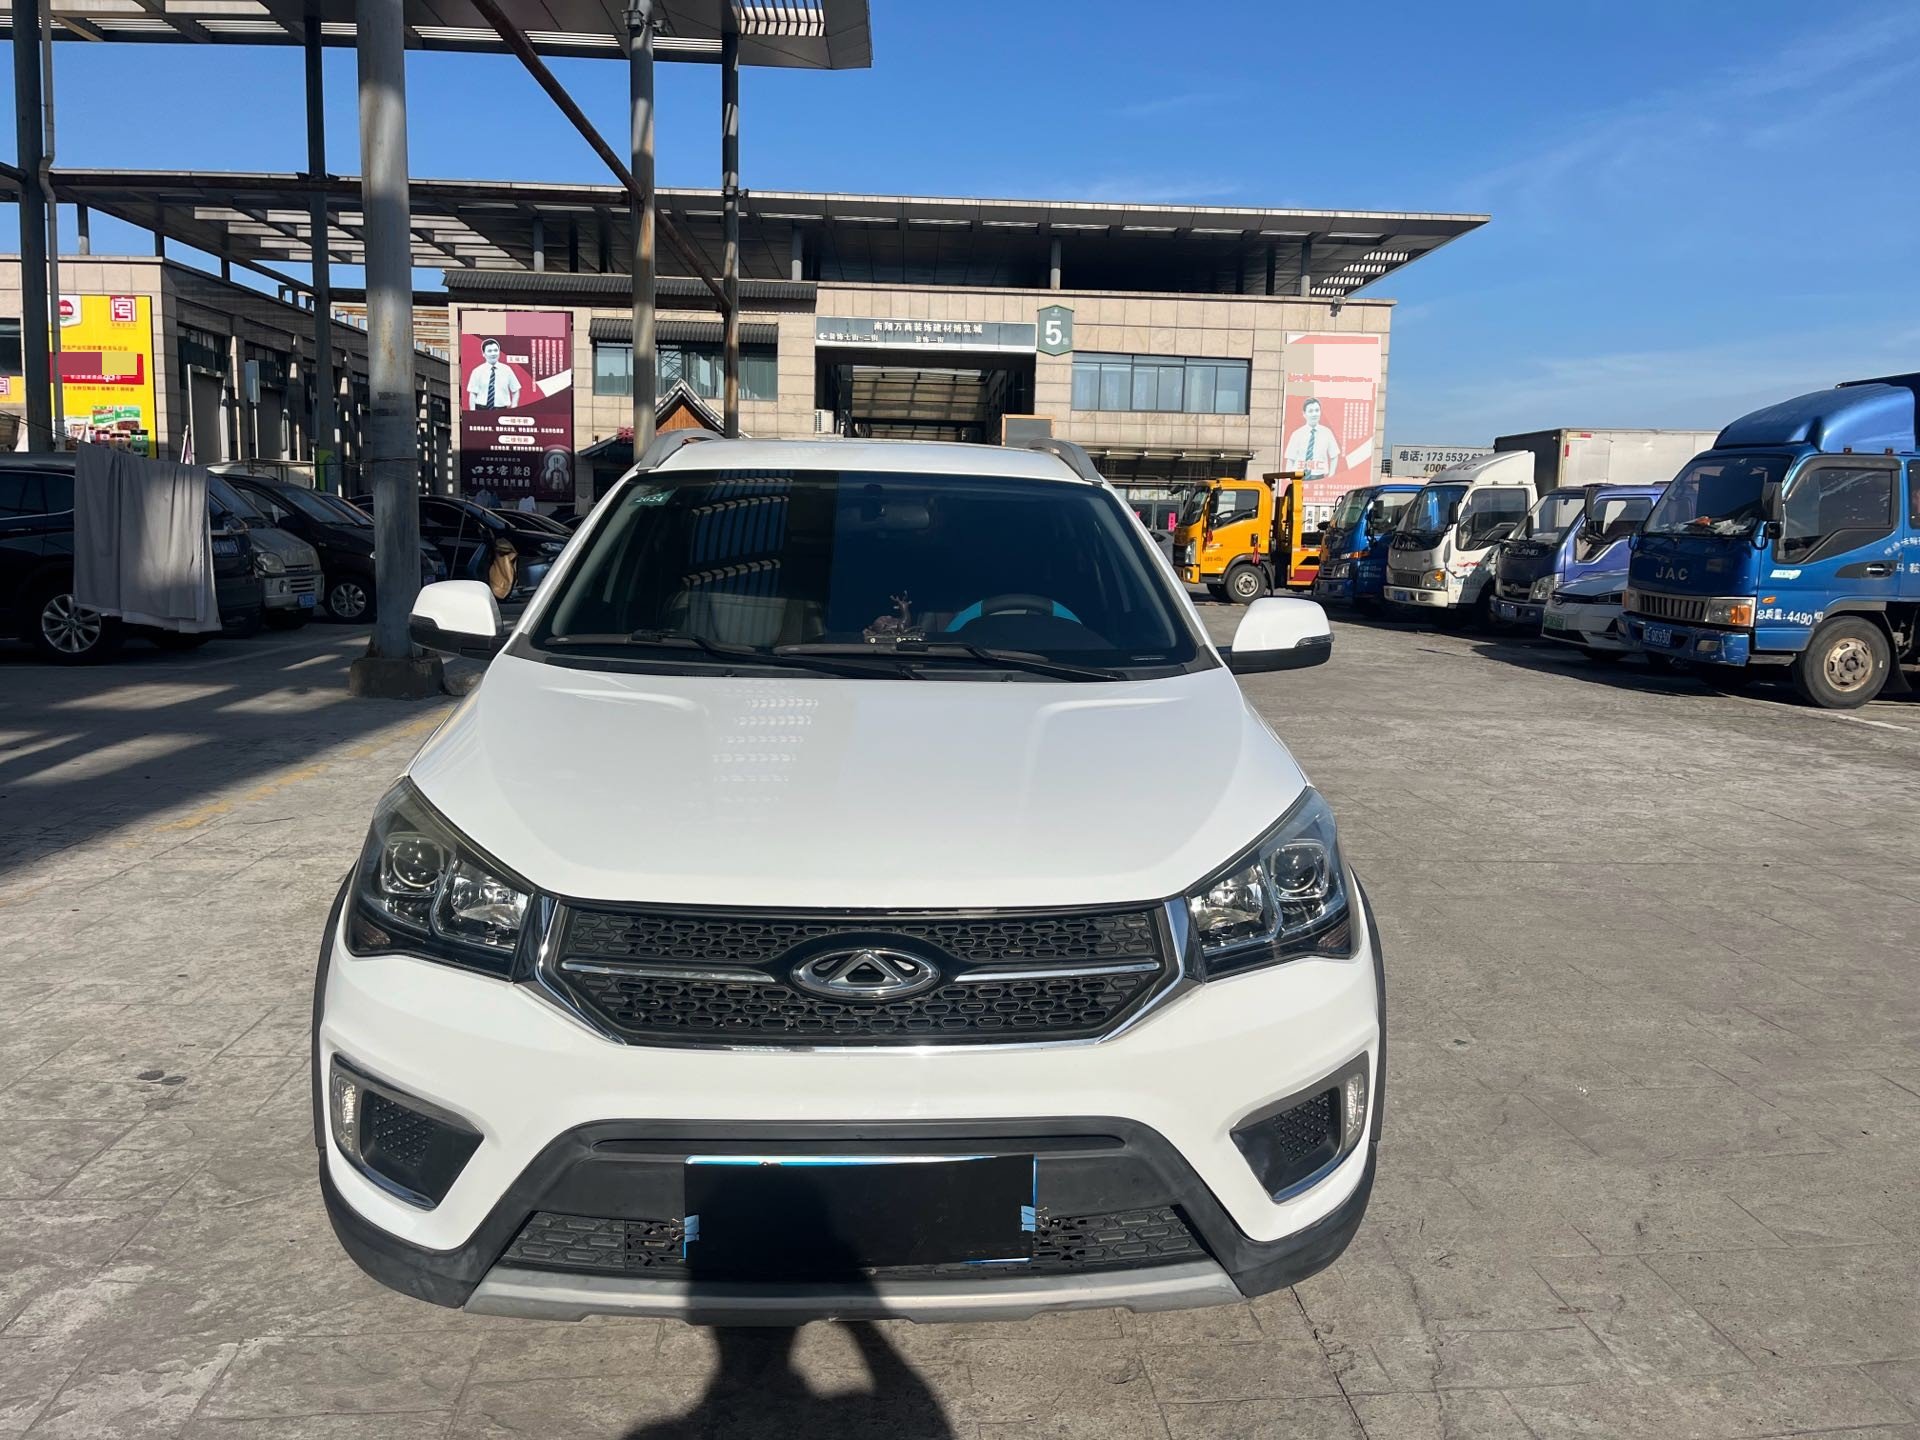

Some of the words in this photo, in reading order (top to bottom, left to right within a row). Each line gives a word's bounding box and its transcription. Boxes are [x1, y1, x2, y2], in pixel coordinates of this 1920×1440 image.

[1045, 320, 1063, 346] 5
[1426, 452, 1443, 462] 173
[1445, 453, 1469, 463] 5532
[635, 494, 664, 502] 2024
[1655, 566, 1689, 581] JAC
